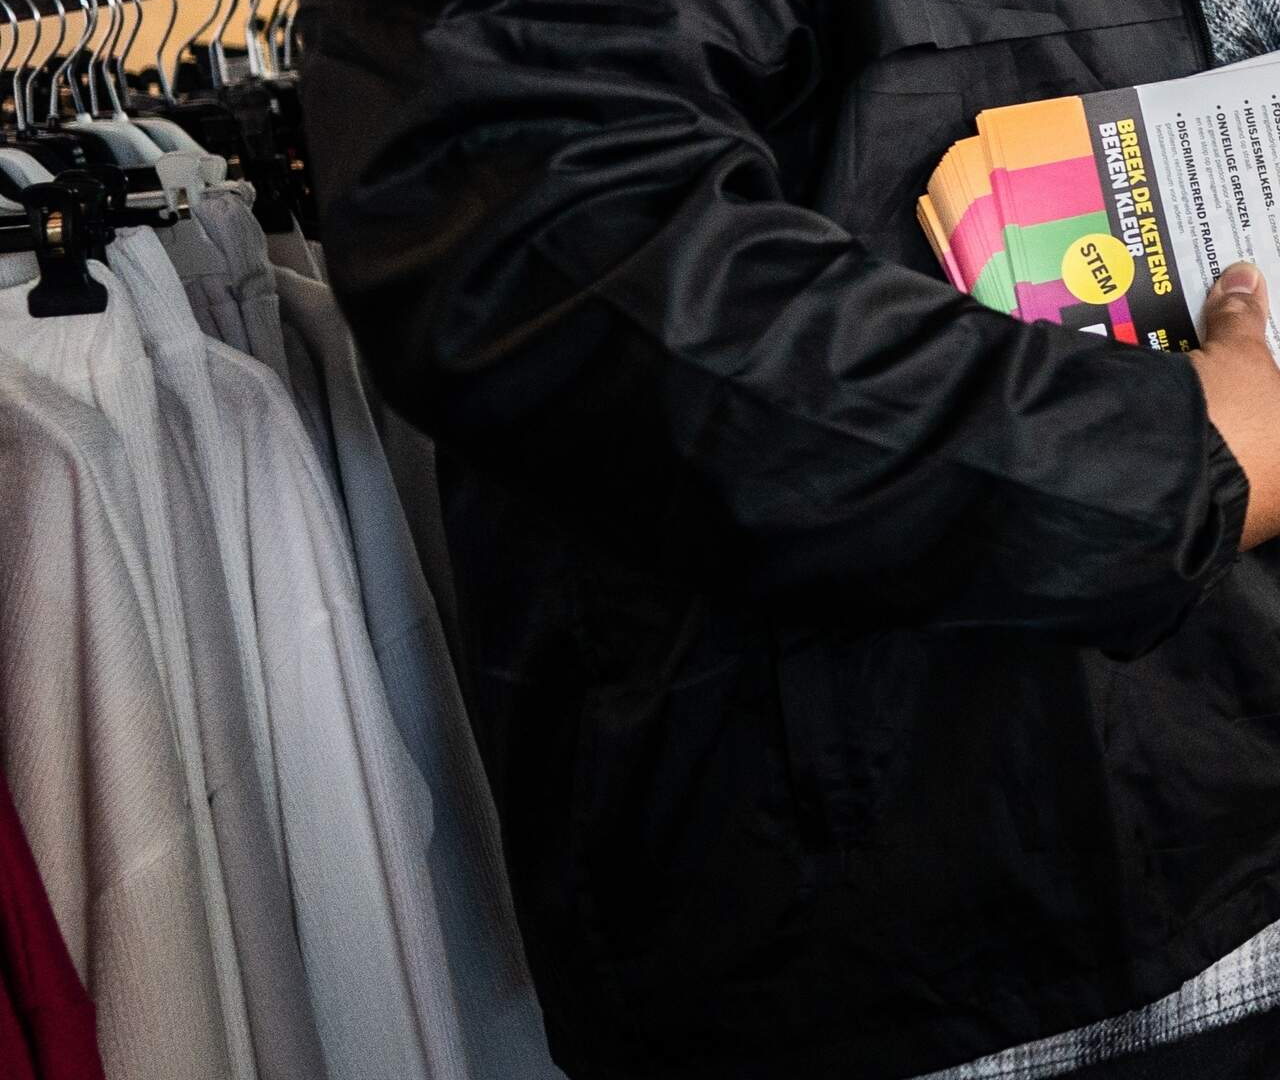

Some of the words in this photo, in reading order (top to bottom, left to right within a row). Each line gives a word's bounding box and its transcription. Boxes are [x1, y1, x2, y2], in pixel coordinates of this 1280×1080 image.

[1098, 121, 1129, 189] BEKEN
[1115, 118, 1147, 185] BREEK
[1215, 112, 1238, 173] ONVEILIGE
[1229, 174, 1251, 231] GRENZEN.
[1242, 107, 1276, 210] HUISJESMELKERS.
[1113, 191, 1145, 257] KLEUR
[1130, 186, 1154, 215] DE
[1175, 120, 1207, 219] DISCRIMINEREND
[1199, 222, 1222, 281] FRAUDEBE
[1080, 243, 1118, 295] STEM
[1138, 216, 1173, 295] KETENS
[1191, 238, 1212, 294] toeslagenschand
